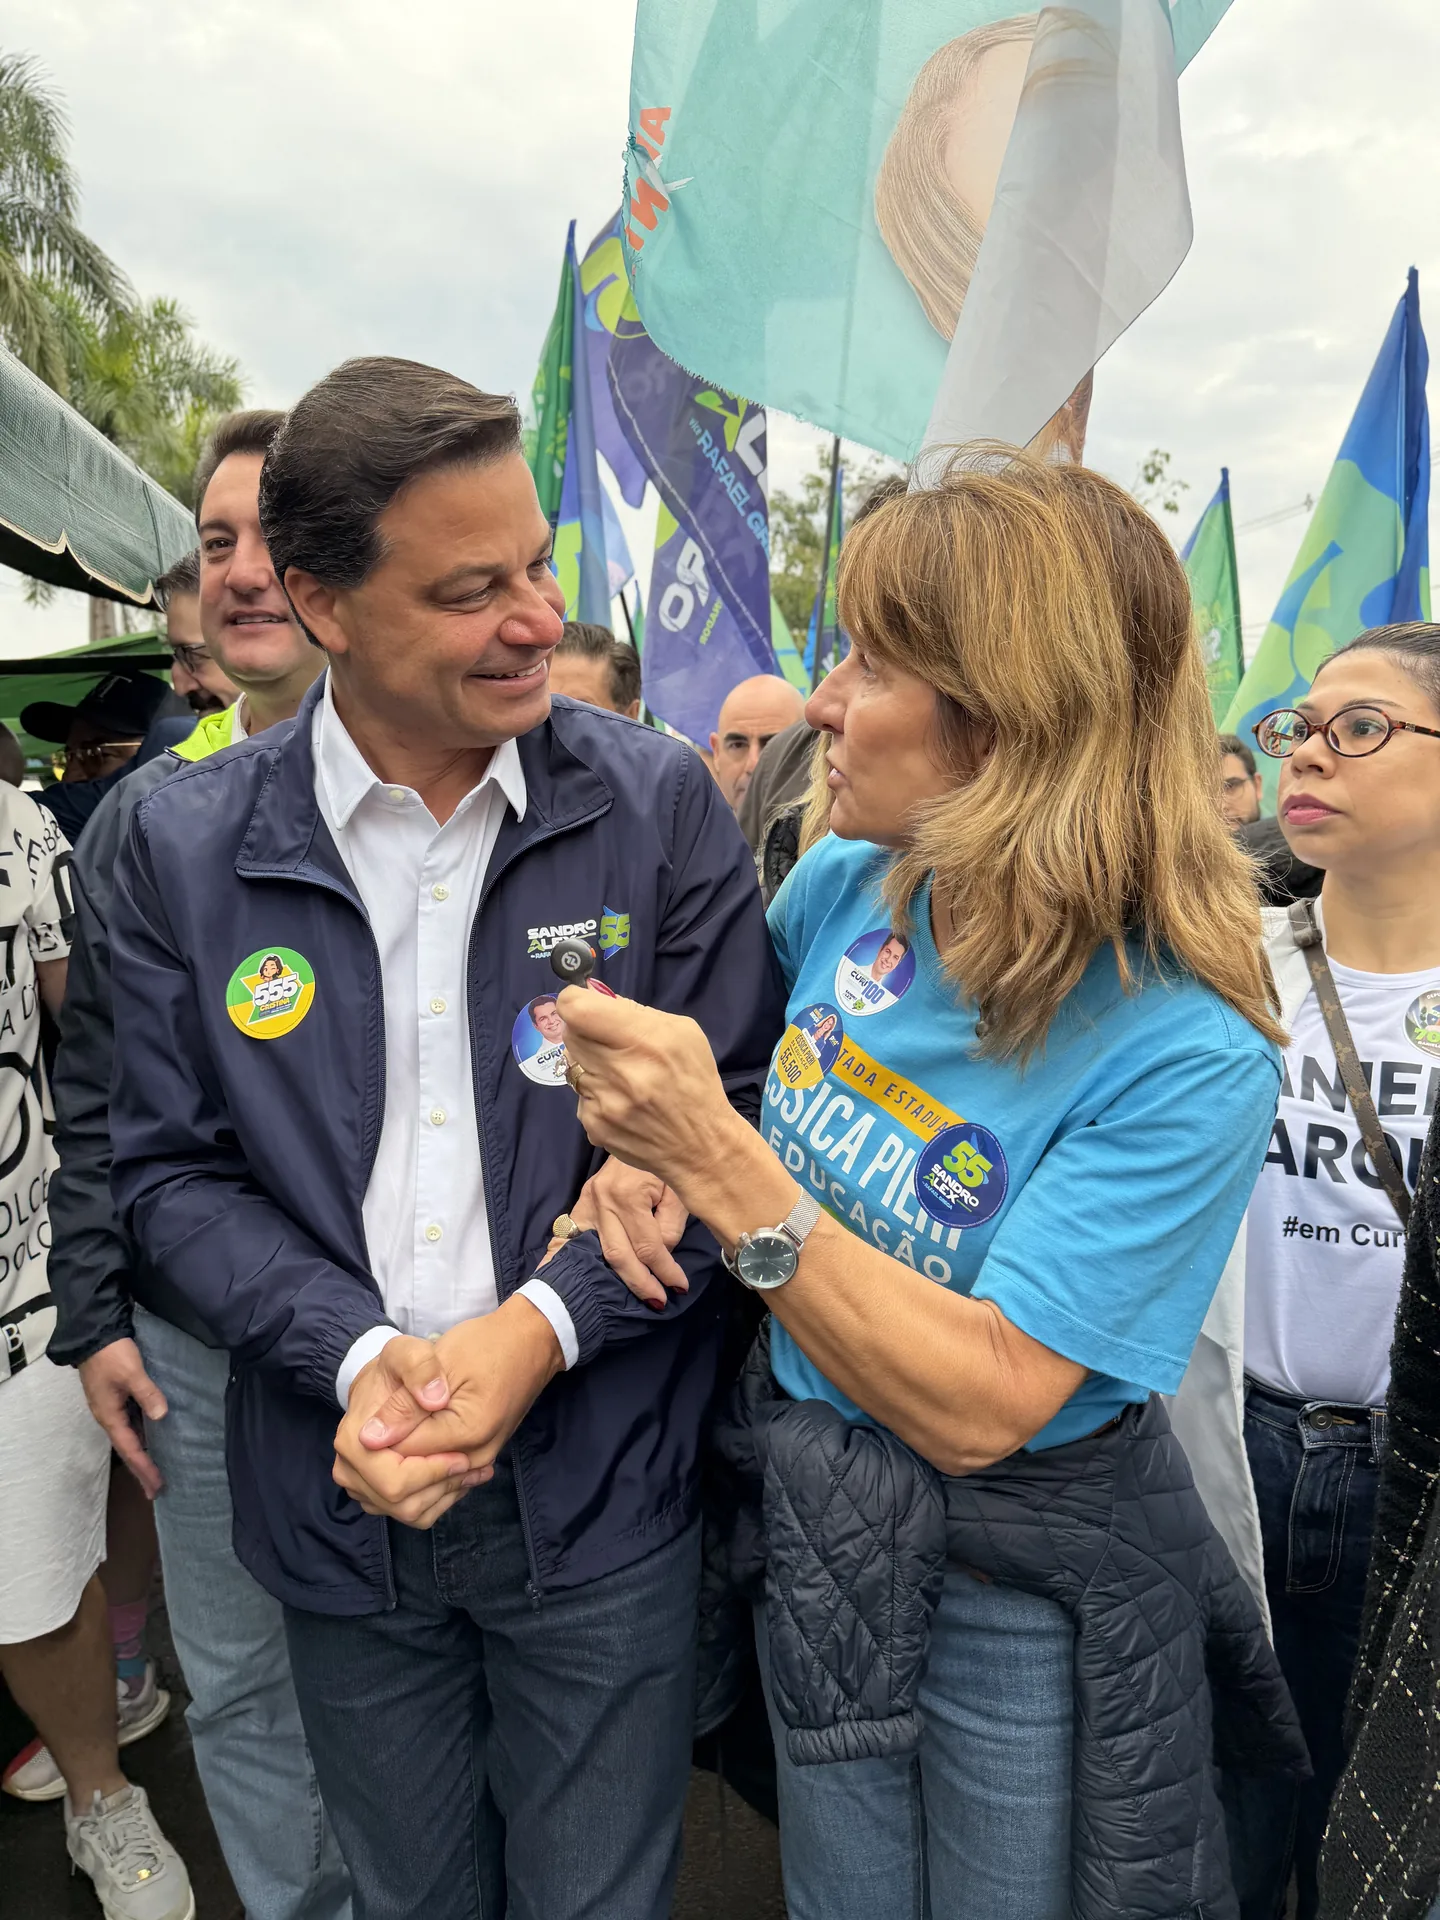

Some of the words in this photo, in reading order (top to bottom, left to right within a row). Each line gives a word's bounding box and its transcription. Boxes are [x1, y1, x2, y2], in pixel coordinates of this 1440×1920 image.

[698, 430, 751, 517] RAFAEL
[527, 919, 598, 940] SANDRO
[599, 913, 630, 950] 55
[254, 974, 298, 1006] 555
[850, 970, 869, 987] CURI
[861, 980, 885, 1005] 100
[780, 1047, 802, 1083] 55.500
[765, 1065, 876, 1175] SSICA
[943, 1140, 993, 1188] 55
[923, 1172, 959, 1204] ALEX
[931, 1164, 979, 1208] SANDRO
[768, 1125, 952, 1284] EDUCAÇÃO
[1282, 1215, 1340, 1243] #em
[1350, 1223, 1406, 1248] Cur
